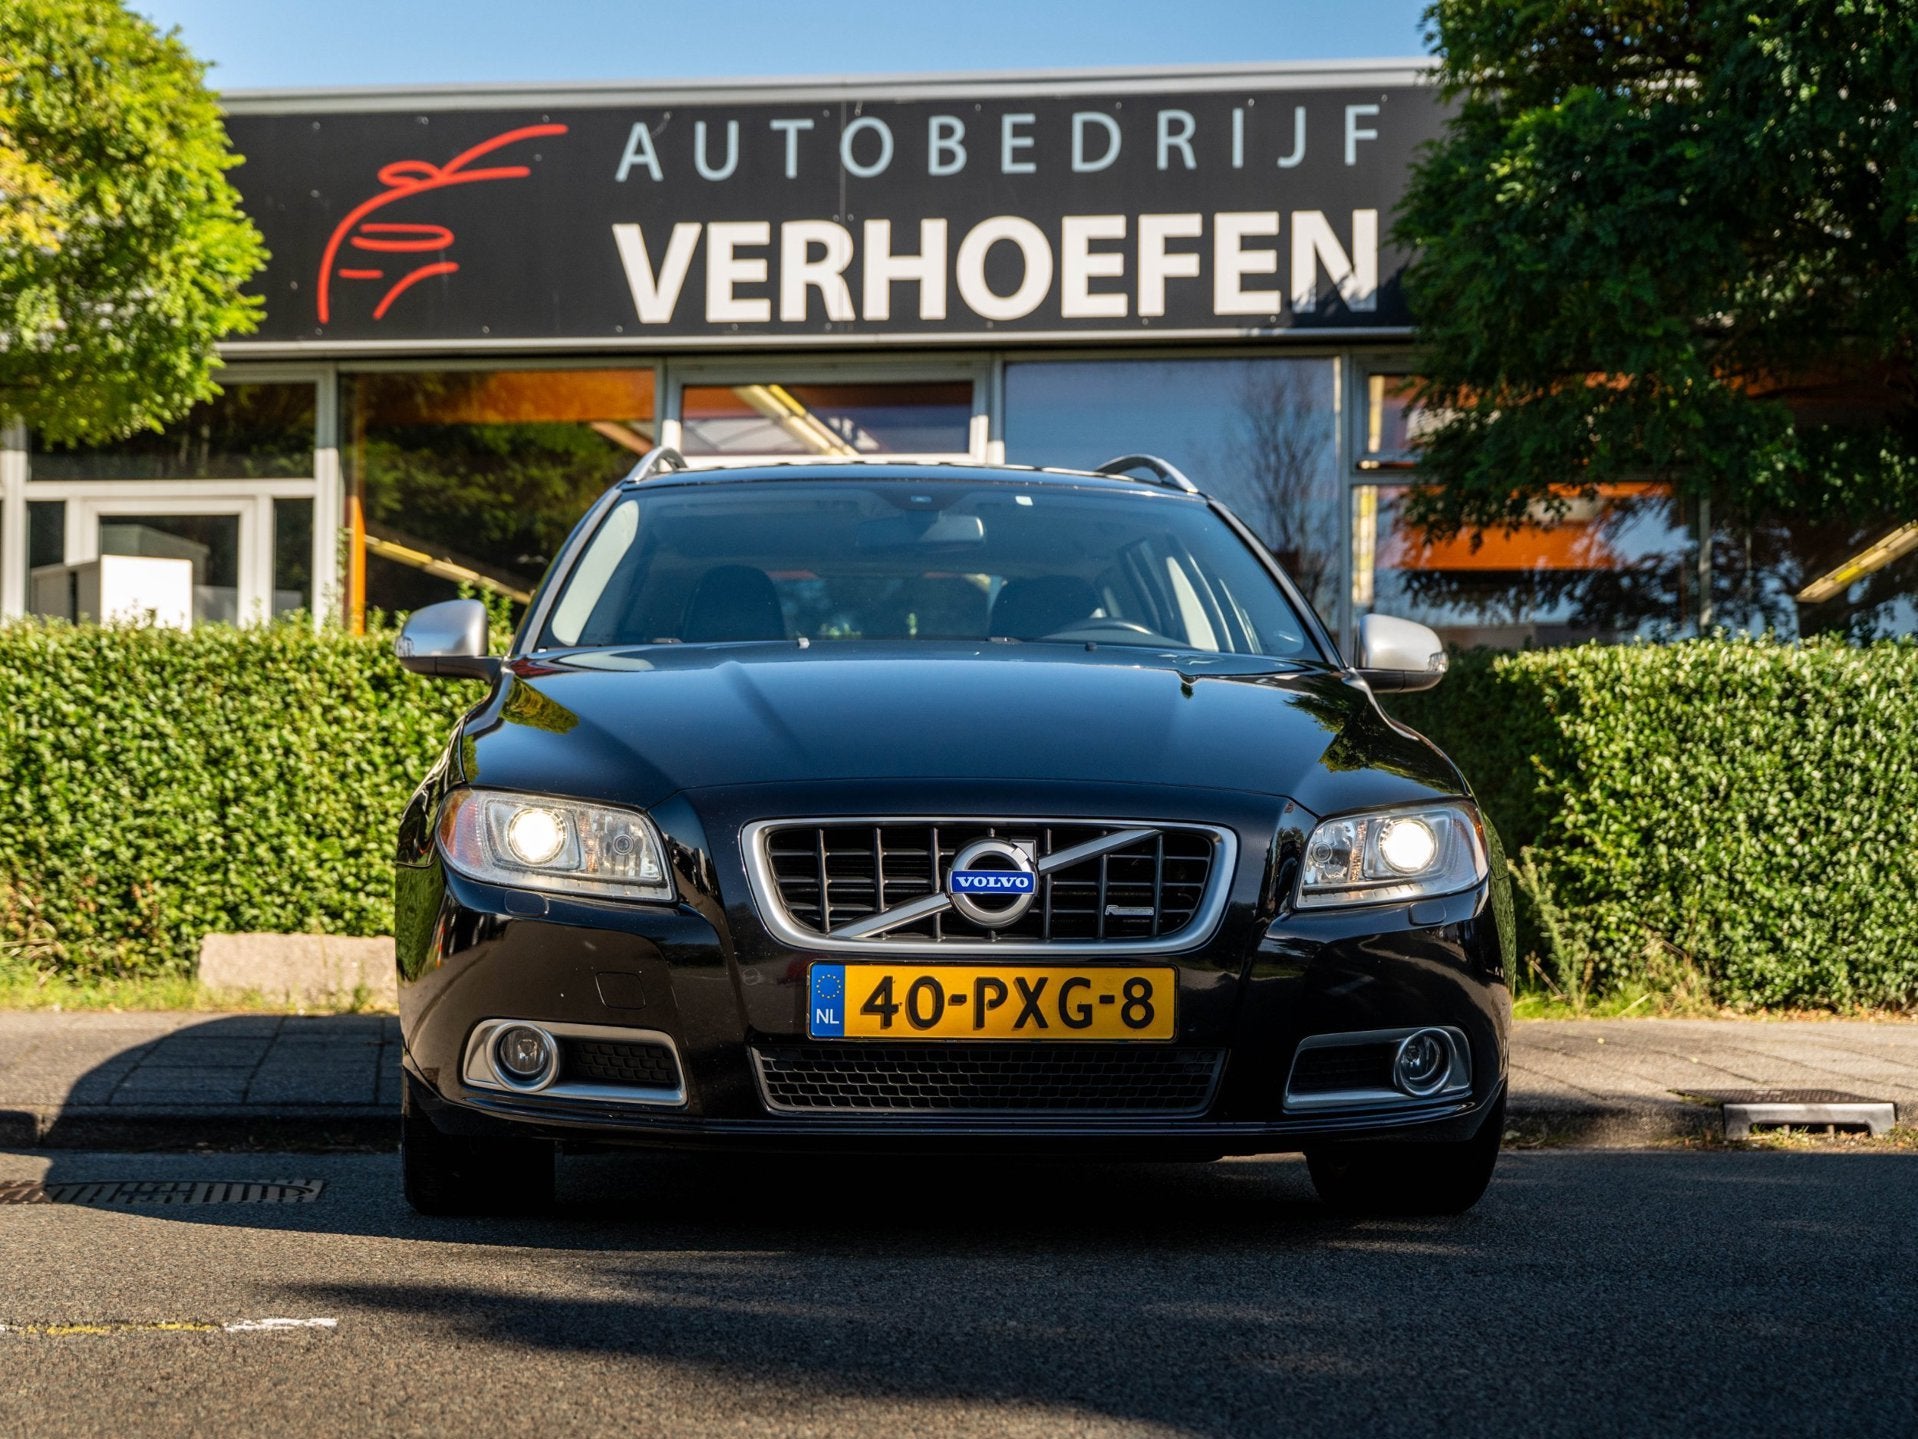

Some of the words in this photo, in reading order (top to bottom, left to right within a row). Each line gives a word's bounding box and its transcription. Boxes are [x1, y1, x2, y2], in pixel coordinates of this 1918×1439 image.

[615, 104, 1380, 182] AUTOBEDRIJF
[611, 208, 1379, 324] VERHOEFEN
[955, 876, 1029, 888] VOLVO
[816, 1008, 840, 1025] NL
[860, 975, 1156, 1032] 40-PXG-8
